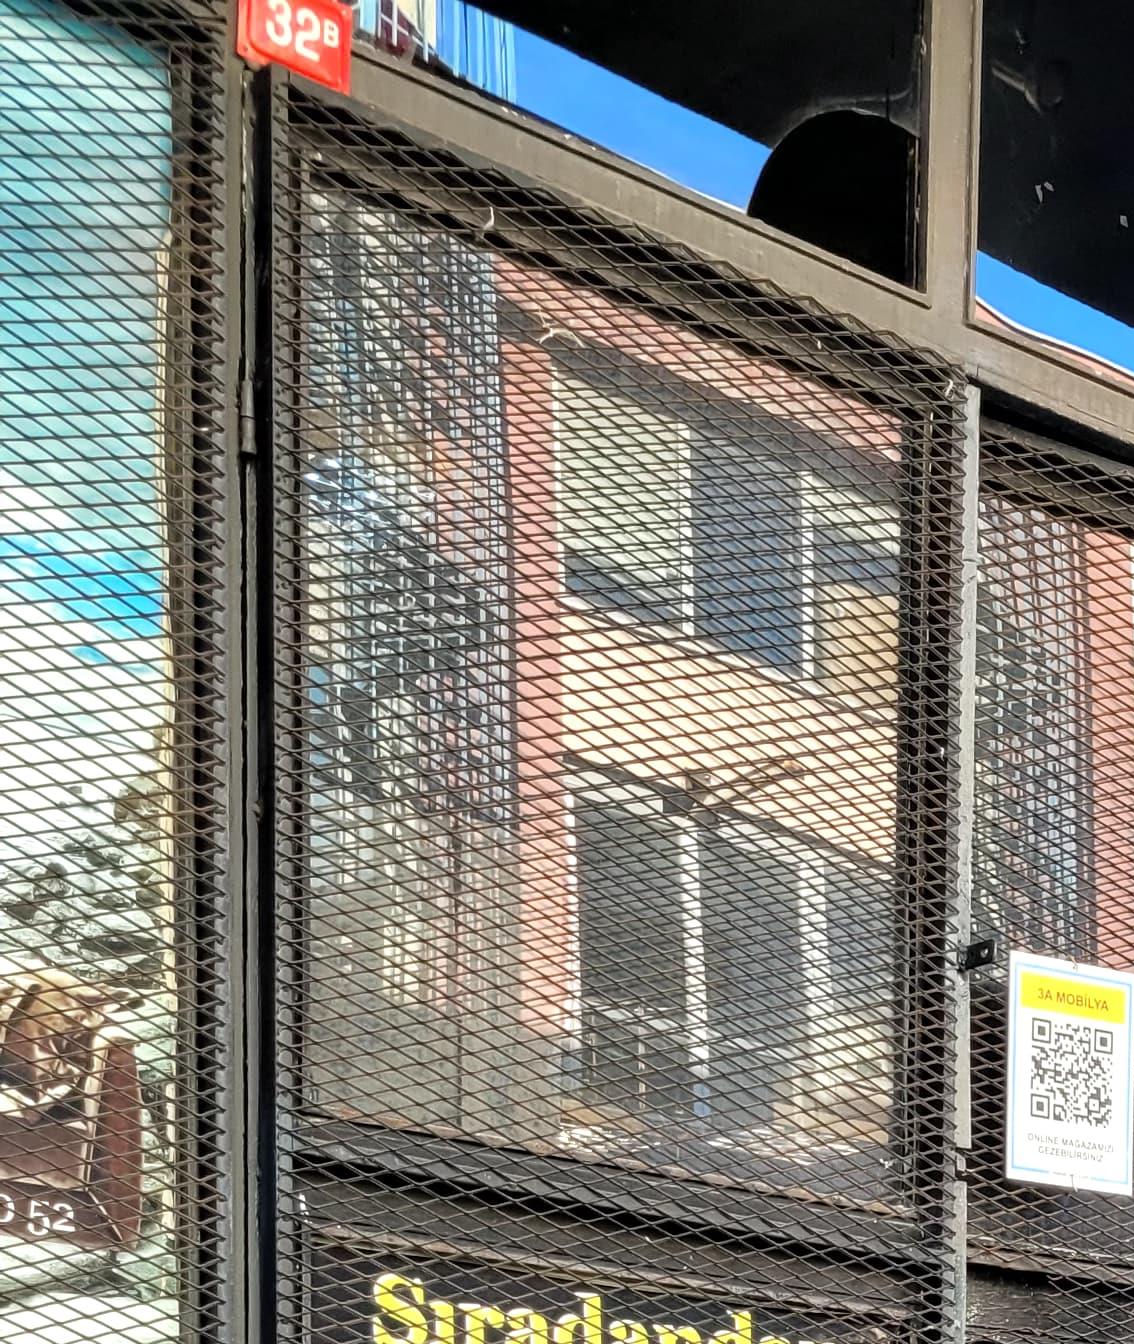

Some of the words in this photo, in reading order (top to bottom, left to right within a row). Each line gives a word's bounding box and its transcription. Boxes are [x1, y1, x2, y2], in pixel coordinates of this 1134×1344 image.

[1037, 987, 1053, 1001] 3A
[1056, 991, 1109, 1012] MOBİLYA
[27, 1199, 76, 1236] 52
